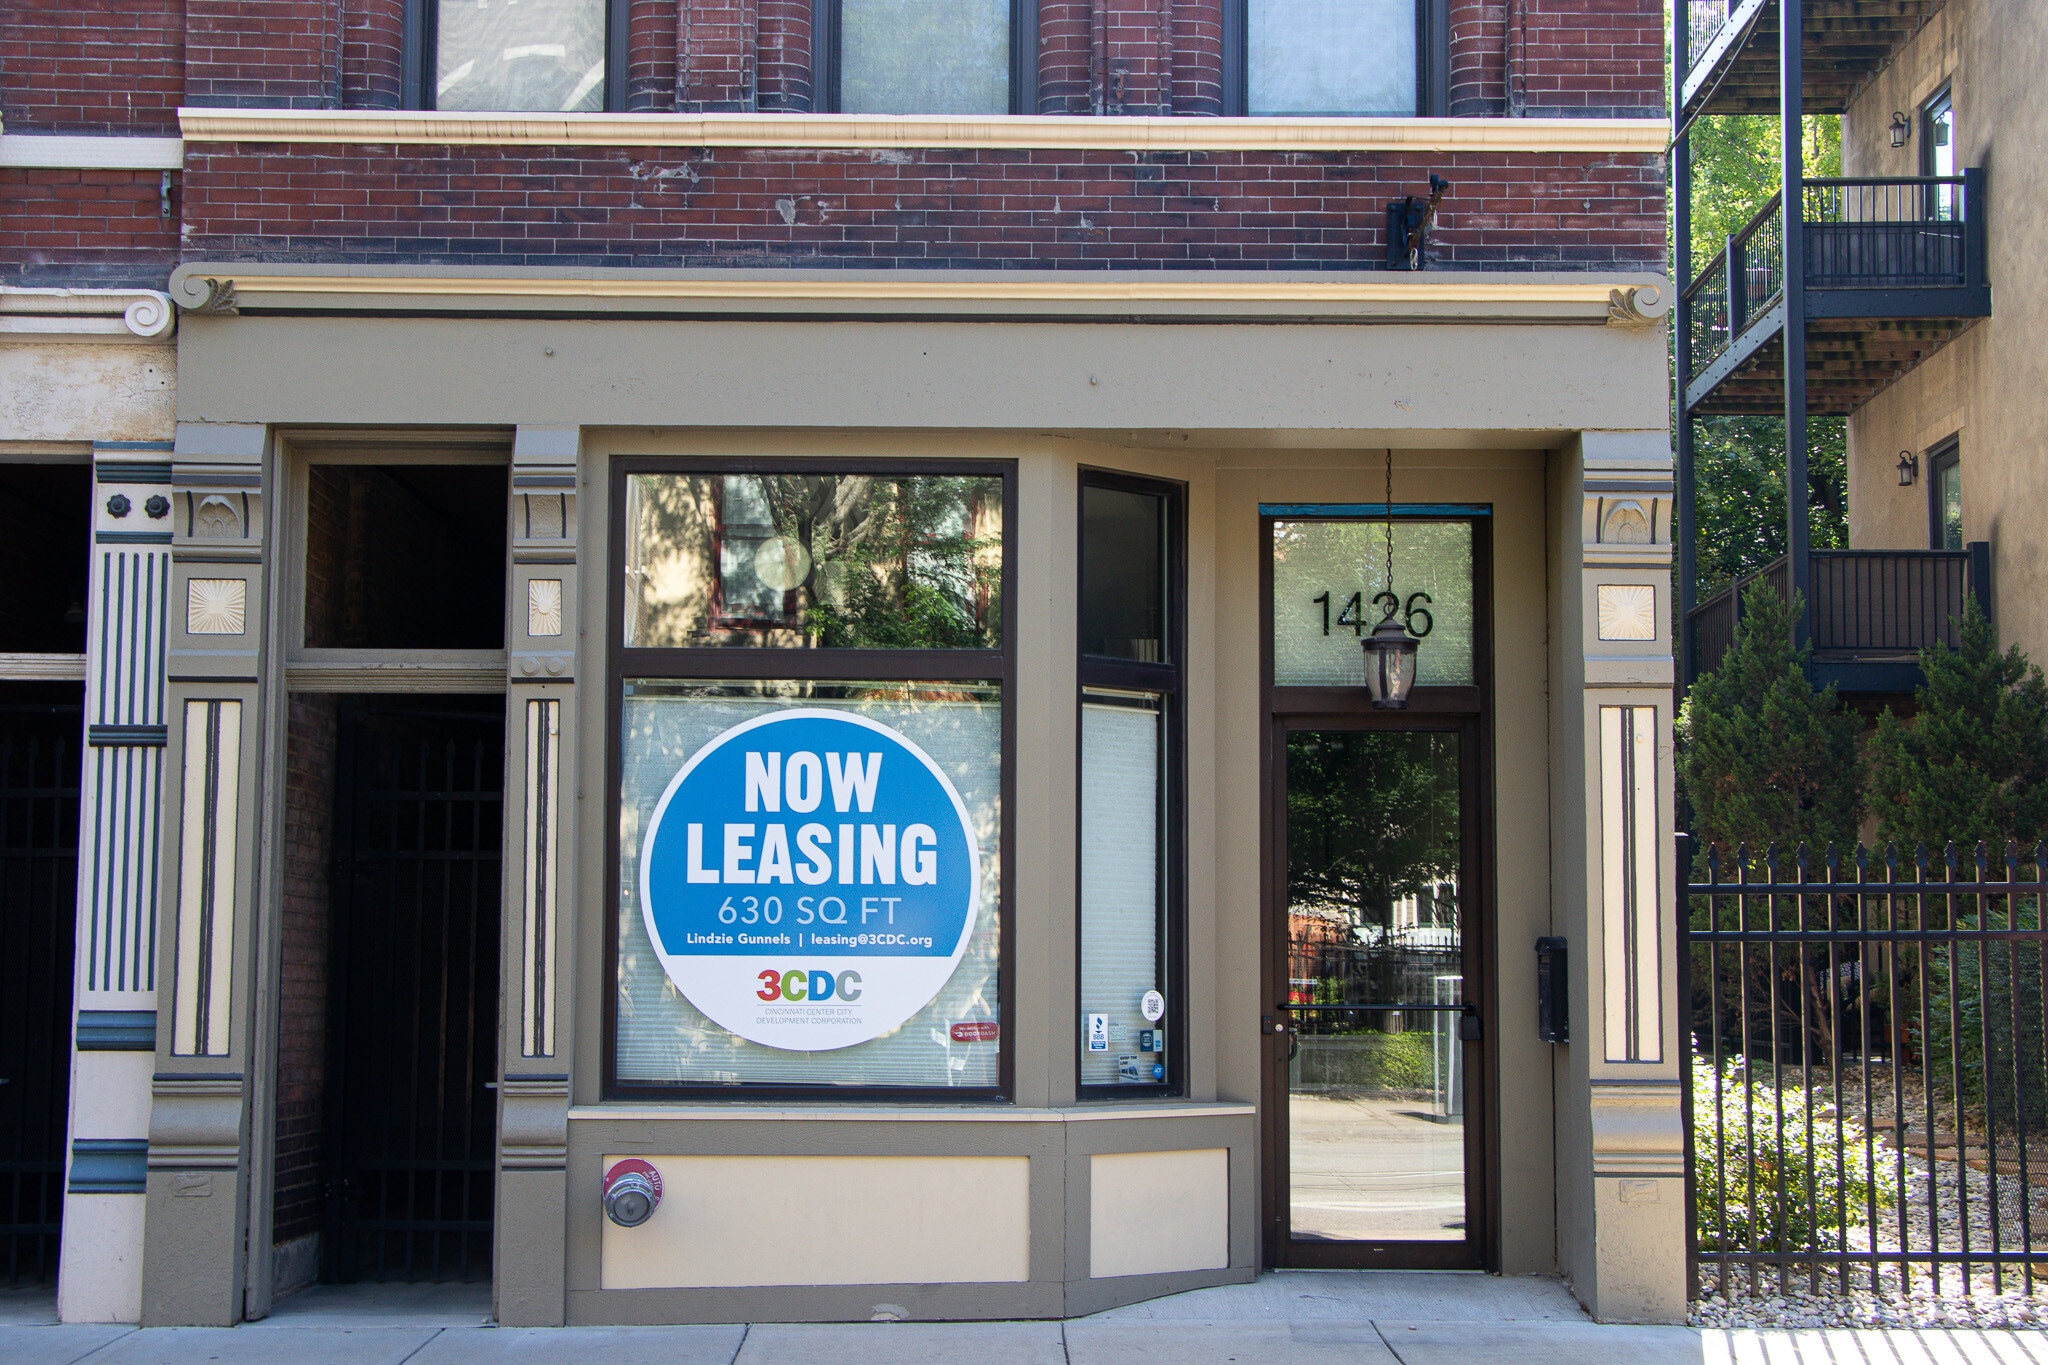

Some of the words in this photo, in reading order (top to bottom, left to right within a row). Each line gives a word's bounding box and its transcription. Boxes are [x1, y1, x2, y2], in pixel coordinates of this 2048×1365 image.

[1313, 591, 1433, 637] 1426
[745, 751, 883, 813] NOW
[686, 823, 938, 885] LEASING
[718, 896, 783, 924] 630
[796, 896, 848, 924] SQ
[861, 897, 902, 924] FT
[686, 932, 734, 944] Lindzie
[737, 933, 791, 944] Gunnels
[811, 933, 933, 949] leasing@3CDC.org
[756, 969, 862, 1001] 3CDC
[806, 1008, 835, 1016] CENTER
[836, 1008, 853, 1016] CITY
[811, 1017, 862, 1025] CORPORATION
[649, 1170, 662, 1191] AUTO
